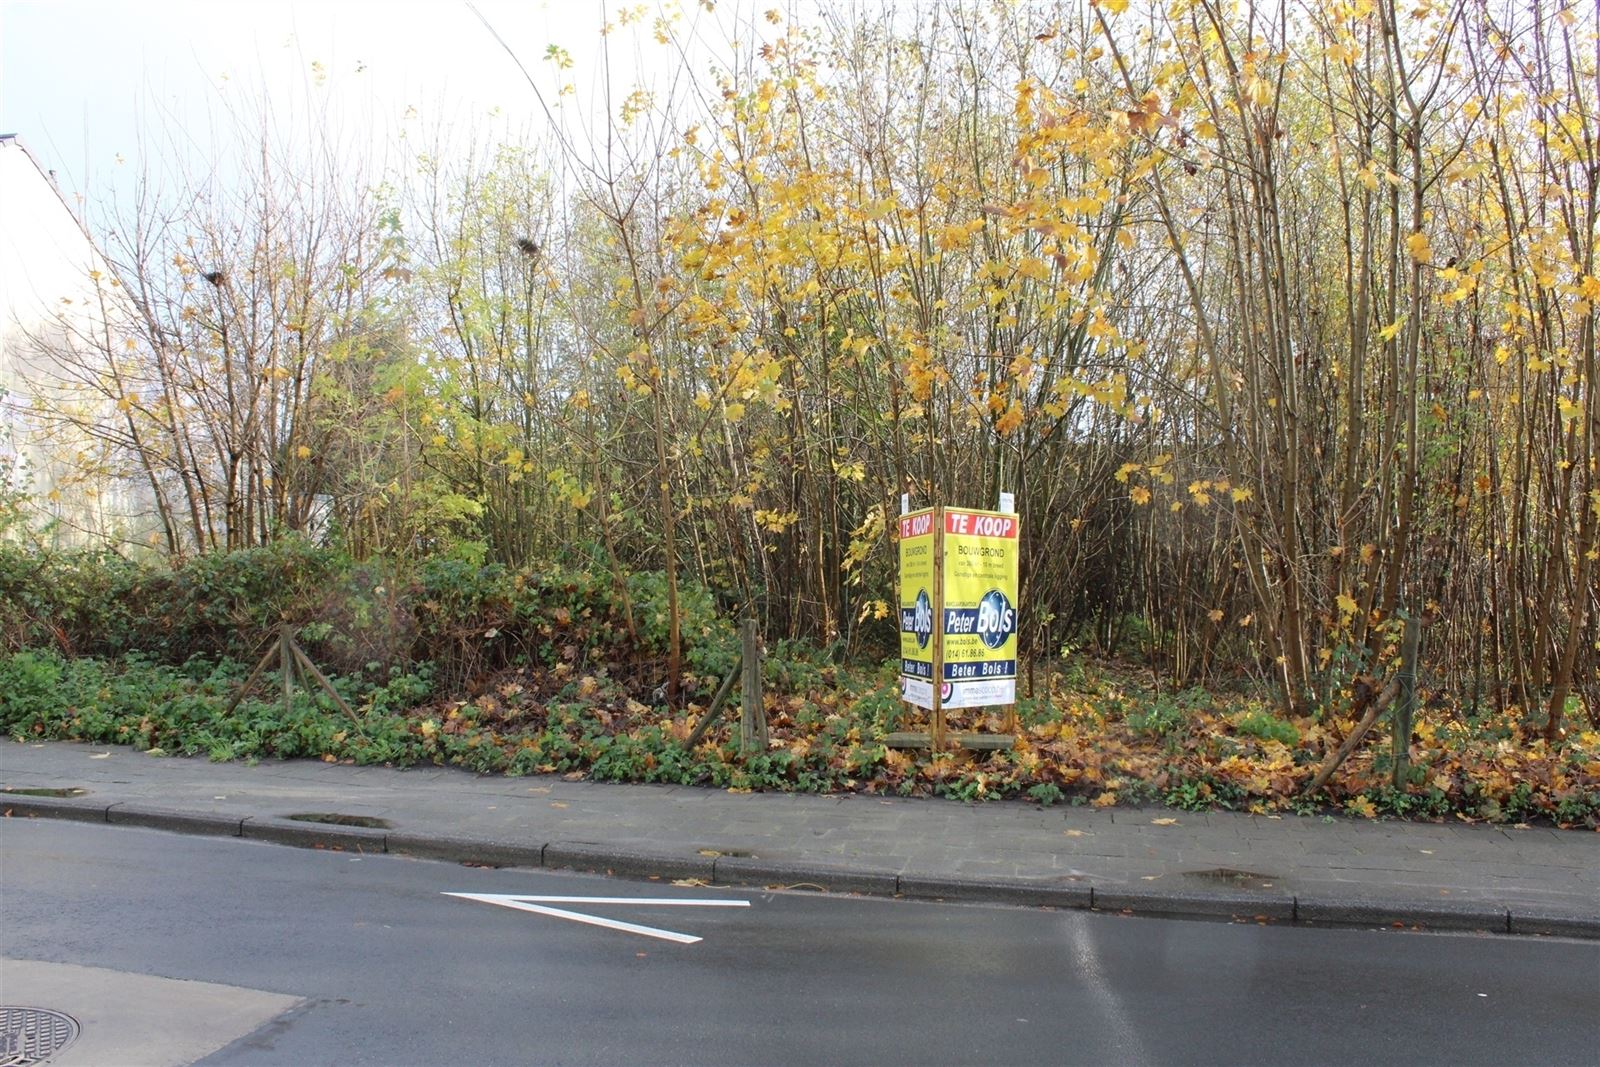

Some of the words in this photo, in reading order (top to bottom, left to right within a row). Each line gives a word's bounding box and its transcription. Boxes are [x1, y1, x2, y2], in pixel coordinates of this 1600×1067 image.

[902, 518, 910, 538] TE
[911, 513, 930, 536] KOOP
[951, 513, 969, 533] TE
[974, 517, 1012, 537] KOOP
[958, 545, 1005, 558] BOUWGROND
[902, 610, 914, 631] Peter
[914, 600, 931, 633] Bols
[946, 611, 975, 633] Peter
[976, 600, 1013, 633] Bols
[946, 638, 978, 646] www.bols.be
[945, 649, 960, 661] (014)
[904, 659, 915, 672] Beter
[916, 661, 926, 675] Bols
[951, 663, 977, 677] Beter
[982, 662, 1001, 675] Bols
[1003, 661, 1009, 674] !
